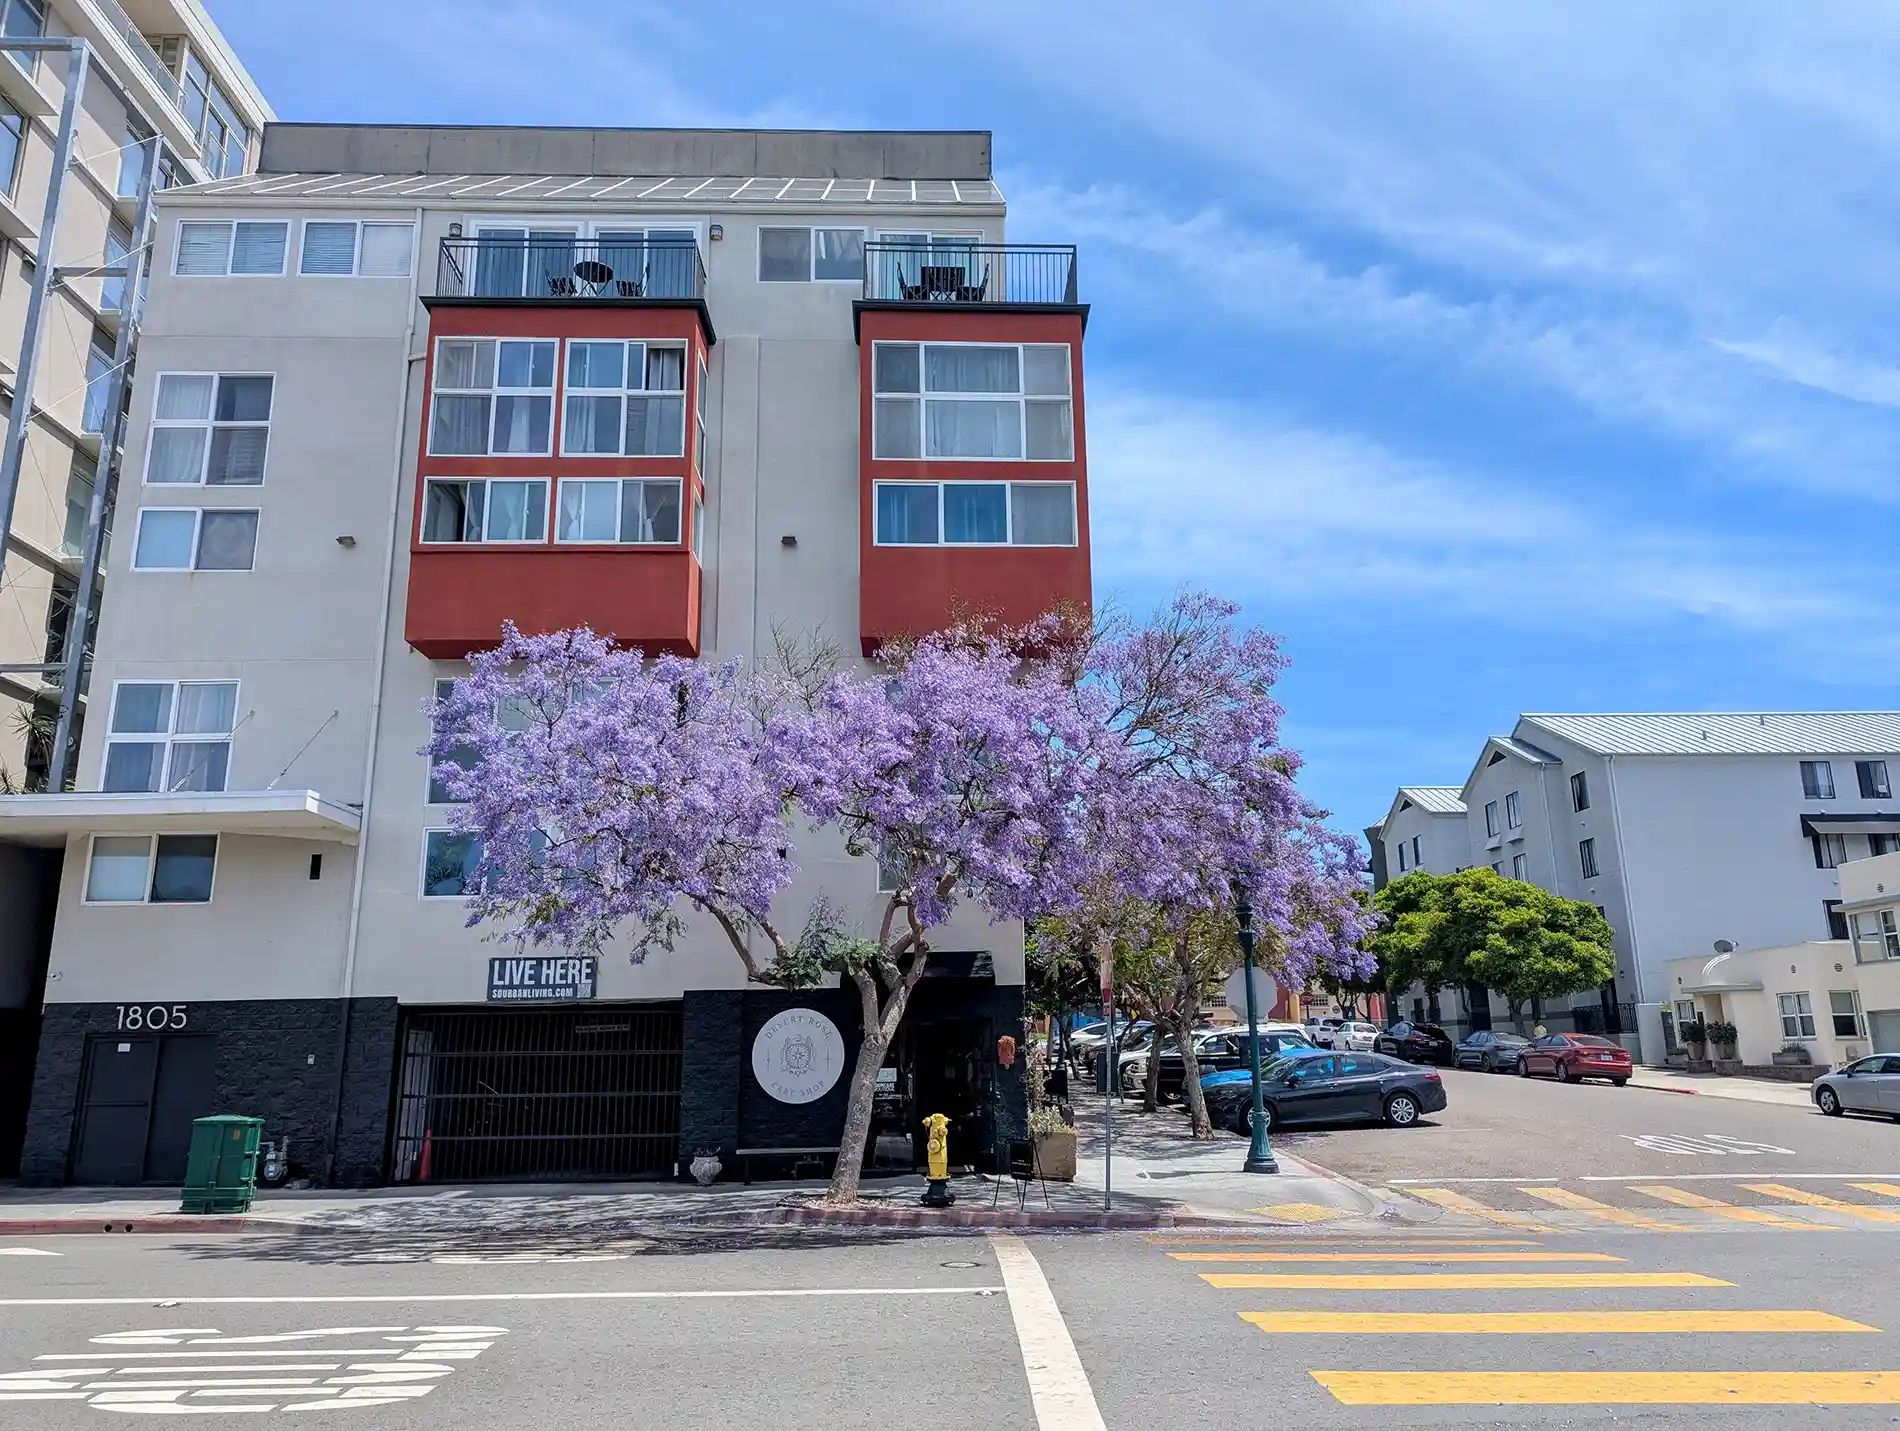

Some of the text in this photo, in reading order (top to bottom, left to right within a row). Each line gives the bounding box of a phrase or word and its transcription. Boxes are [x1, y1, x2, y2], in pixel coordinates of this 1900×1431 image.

[493, 958, 593, 985] LIVE HERE
[492, 987, 573, 998] SDURBANLIVING.COM
[116, 1005, 187, 1030] 1805
[764, 1015, 833, 1039] DESERT ROSE
[800, 1080, 824, 1097] SHOP
